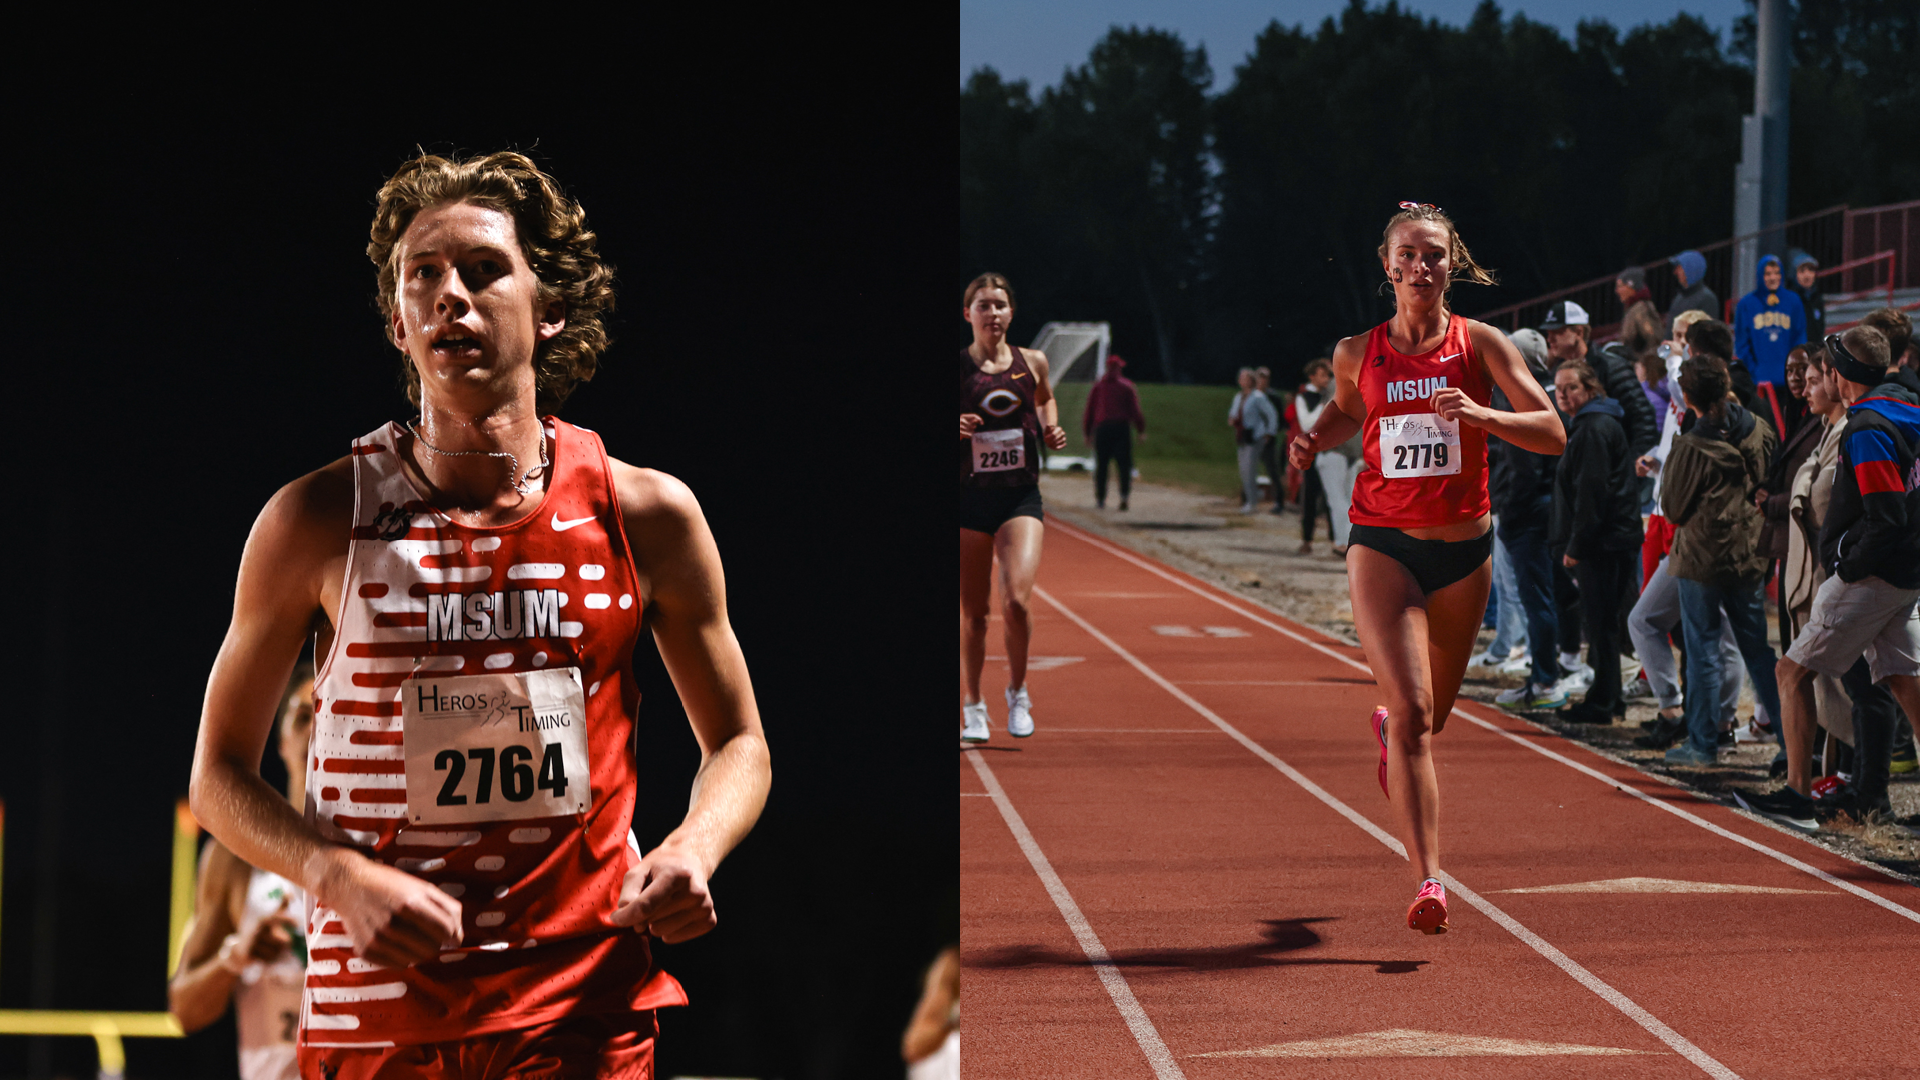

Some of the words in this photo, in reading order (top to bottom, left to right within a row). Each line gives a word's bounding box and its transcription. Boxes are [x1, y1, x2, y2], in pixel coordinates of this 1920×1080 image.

[980, 449, 1019, 468] 2246
[1393, 442, 1449, 470] 2779
[426, 588, 561, 642] MSUM
[417, 684, 488, 713] HERO'S
[510, 704, 571, 733] TIMING
[433, 742, 569, 806] 2764
